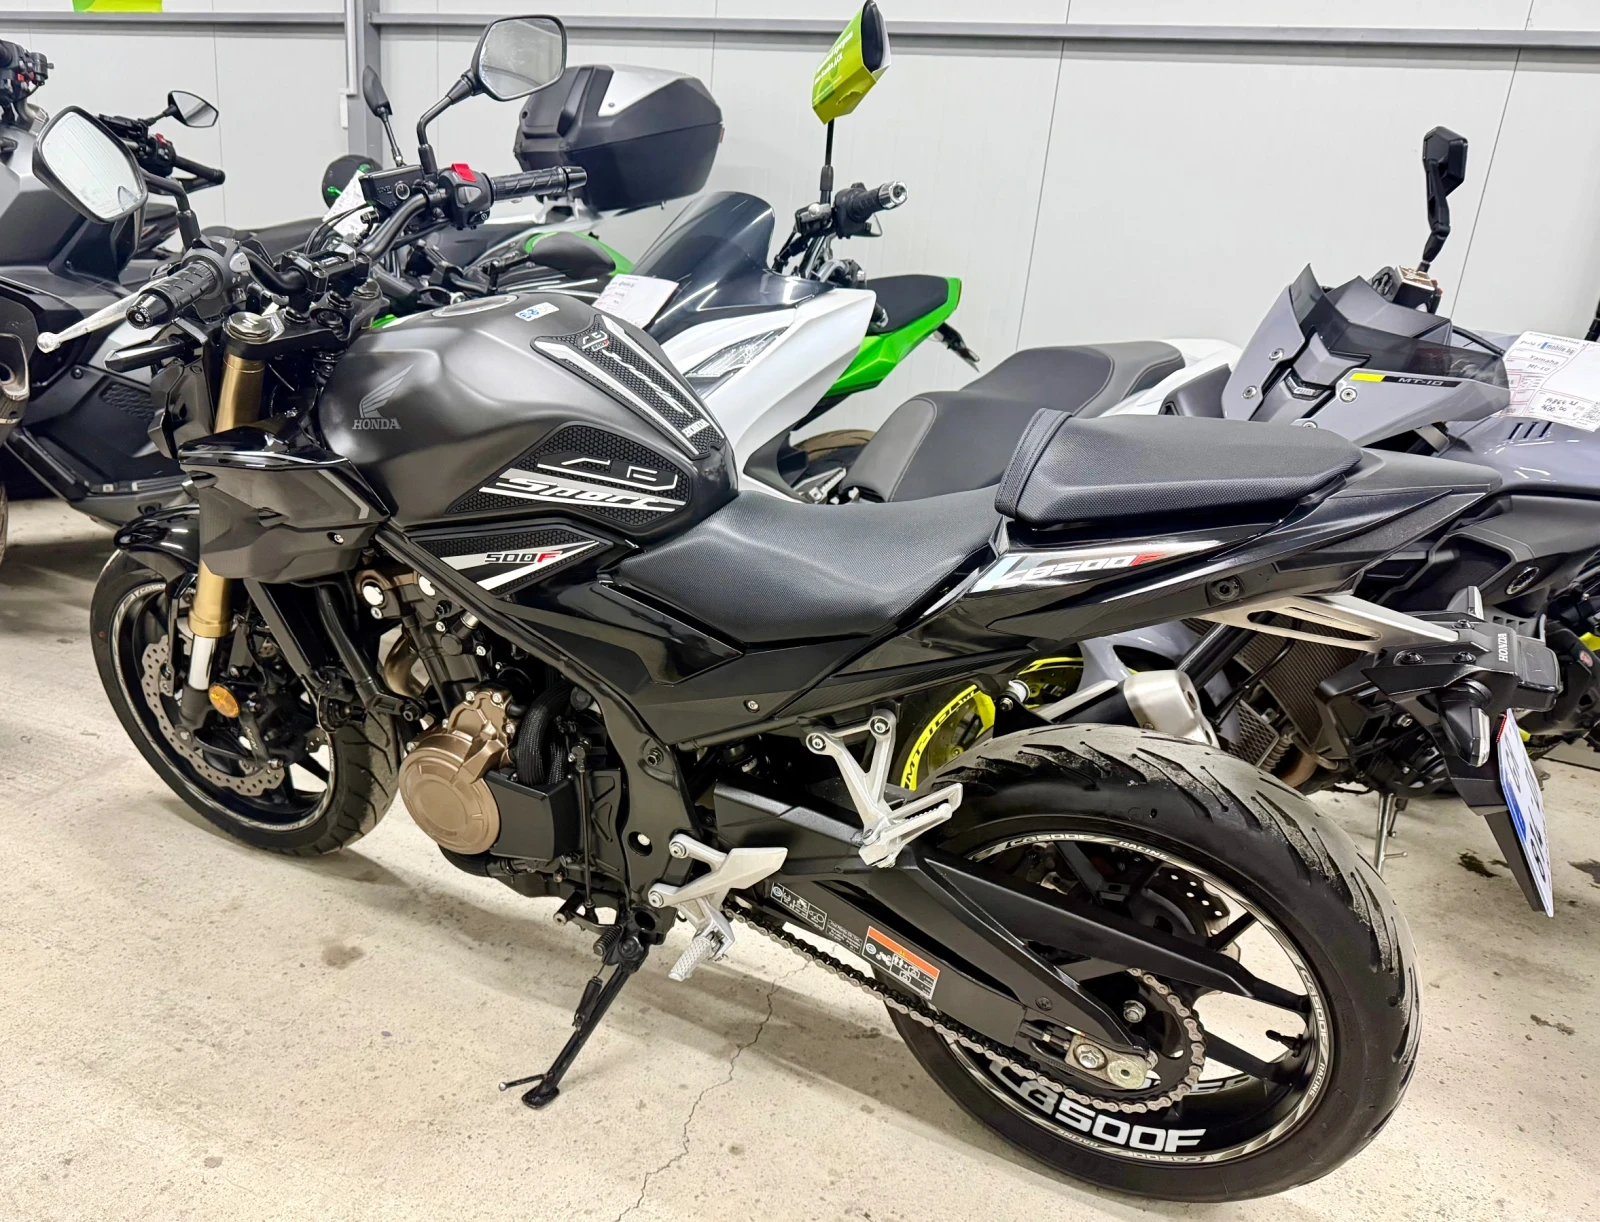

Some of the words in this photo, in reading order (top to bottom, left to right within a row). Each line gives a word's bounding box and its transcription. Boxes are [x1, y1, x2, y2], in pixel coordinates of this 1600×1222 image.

[1398, 377, 1444, 387] MT-10
[352, 418, 402, 431] HONDA
[484, 550, 564, 564] 500F
[1003, 553, 1167, 583] CB500F
[1497, 632, 1509, 663] HONDA
[1009, 832, 1096, 849] CB500F
[1118, 840, 1169, 861] RACING
[1300, 968, 1329, 1047] CB500F
[1308, 1062, 1326, 1098] RACING
[987, 1059, 1207, 1153] CB500F
